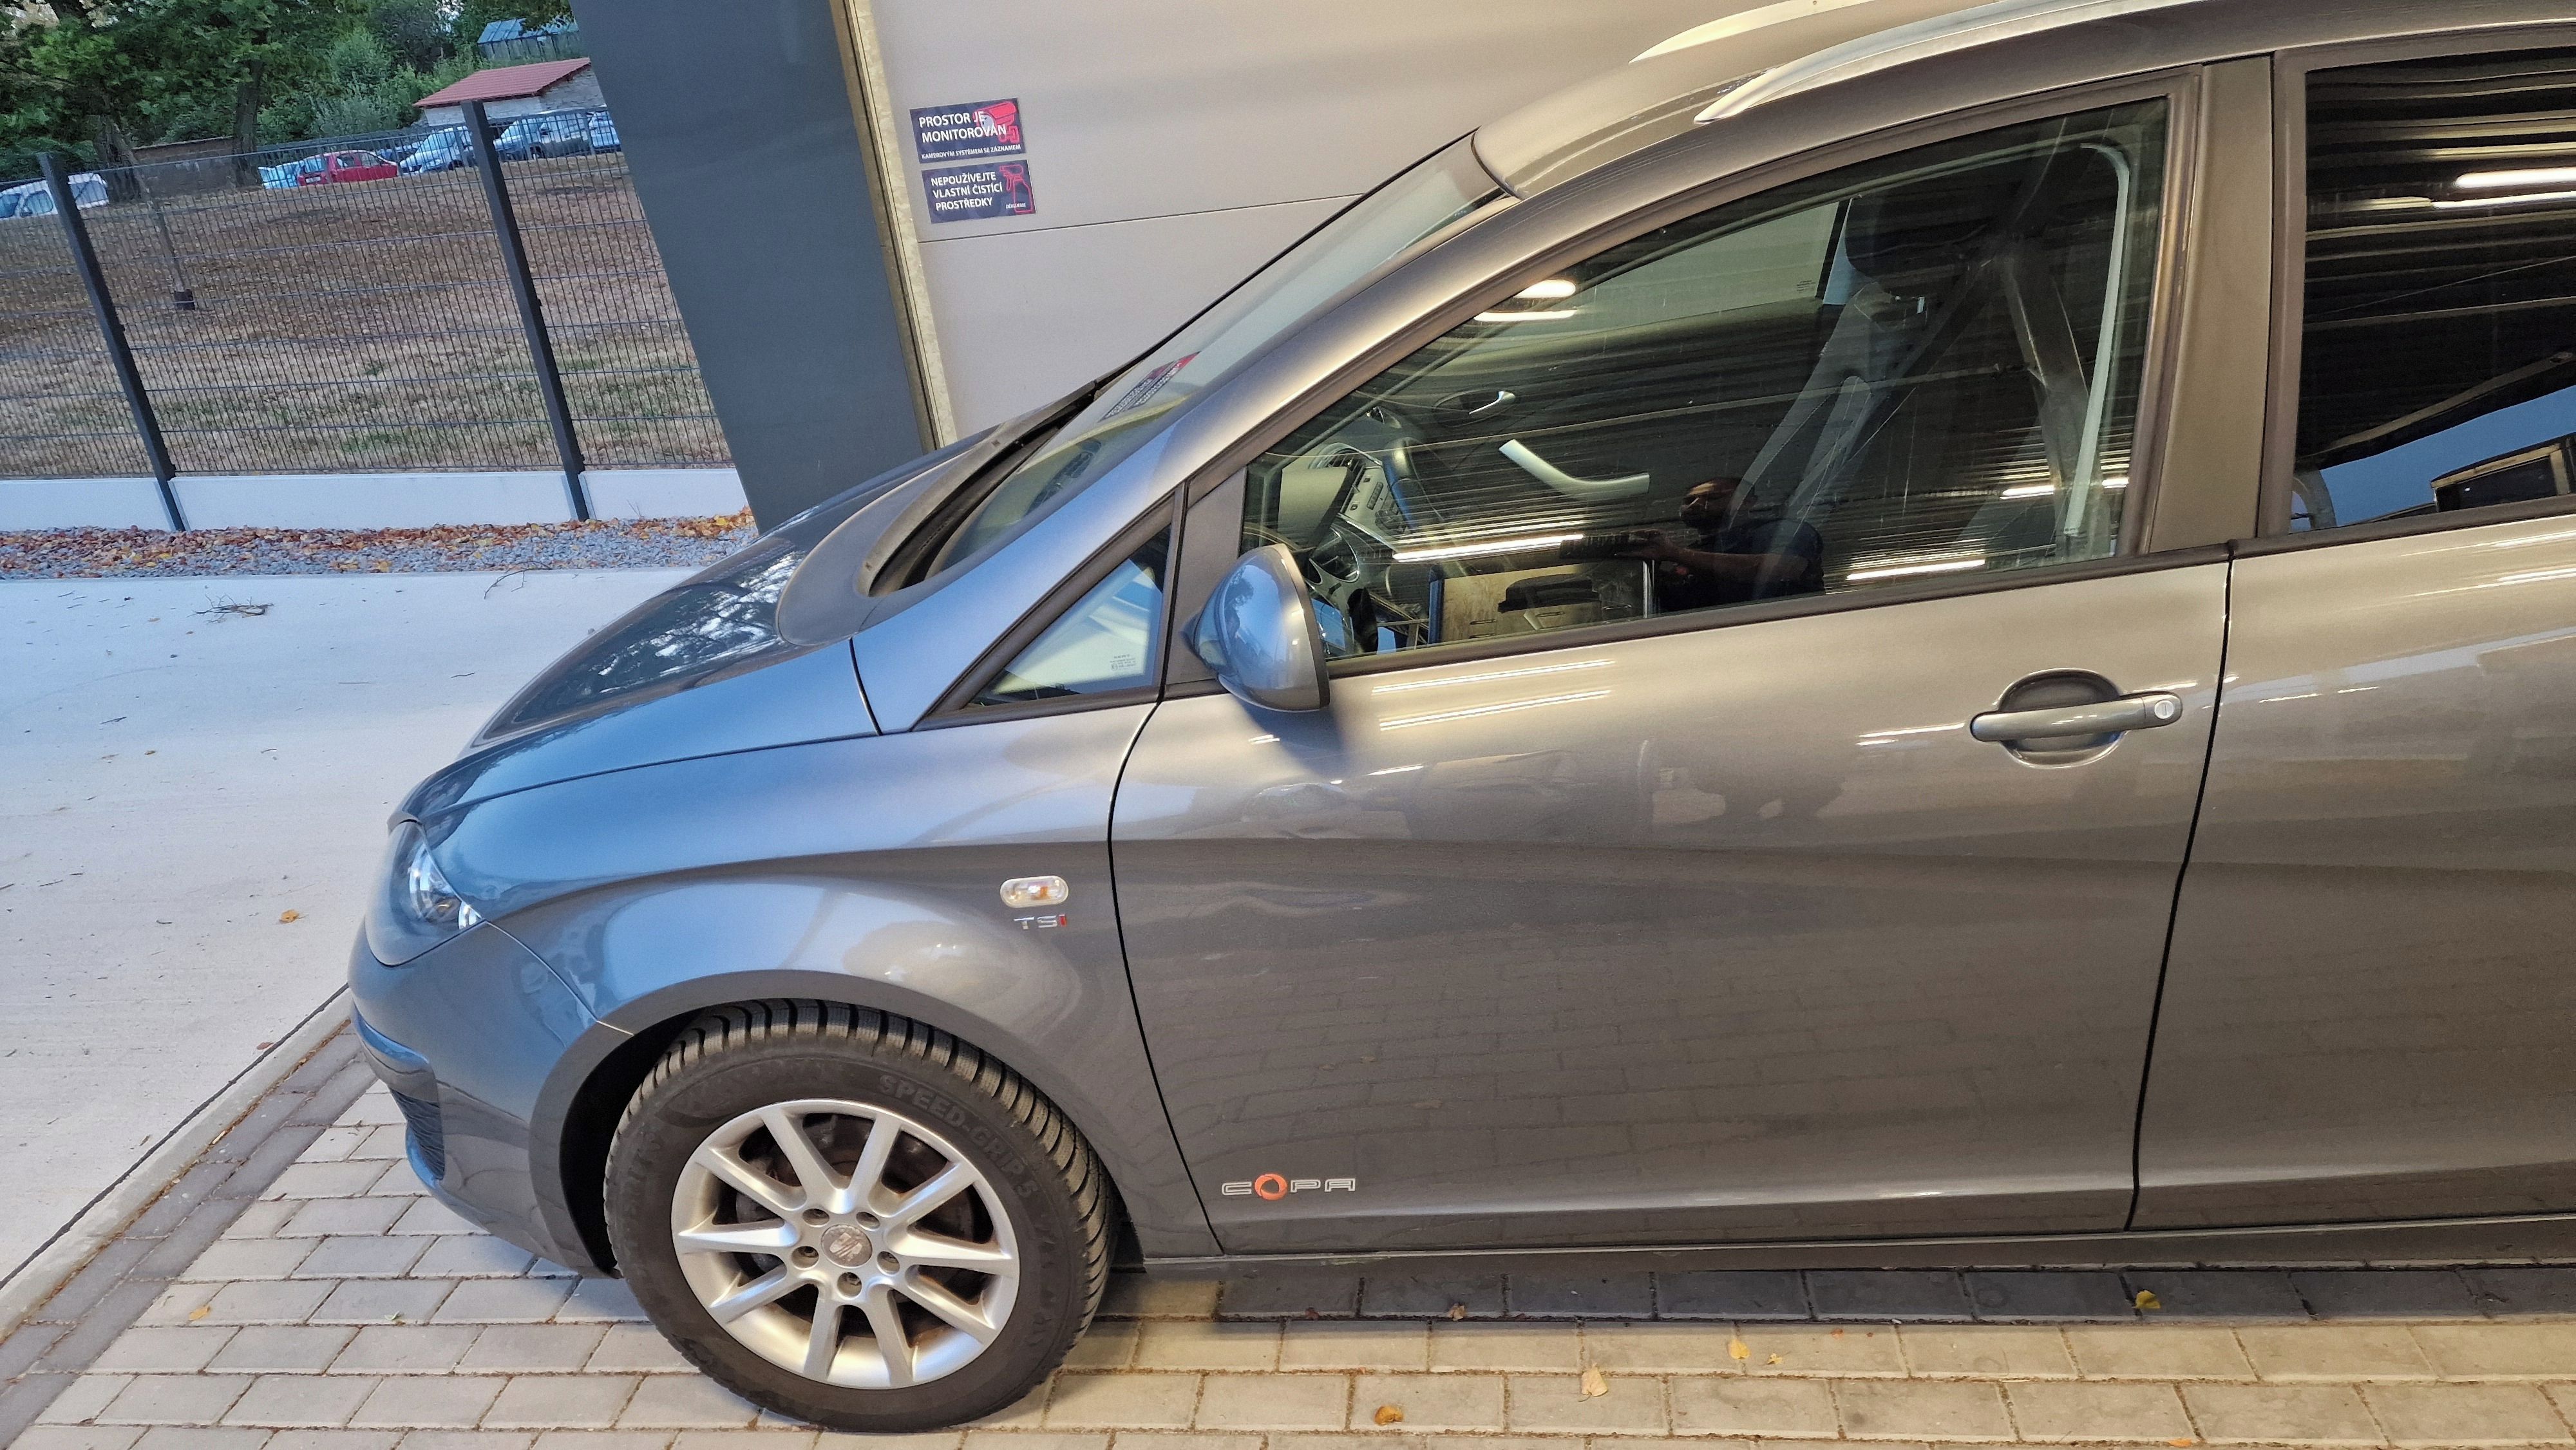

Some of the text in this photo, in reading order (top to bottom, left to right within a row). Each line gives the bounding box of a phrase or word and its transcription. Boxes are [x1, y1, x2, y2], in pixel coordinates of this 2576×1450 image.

[918, 111, 985, 128] PROSTOR JE
[931, 171, 997, 187] NEPOUŽÍVEJTE
[933, 182, 1003, 198] VLASTNÍ ČISTÍCÍ
[935, 197, 992, 211] PROSTŘEDKY
[1221, 1173, 1356, 1201] COPA
